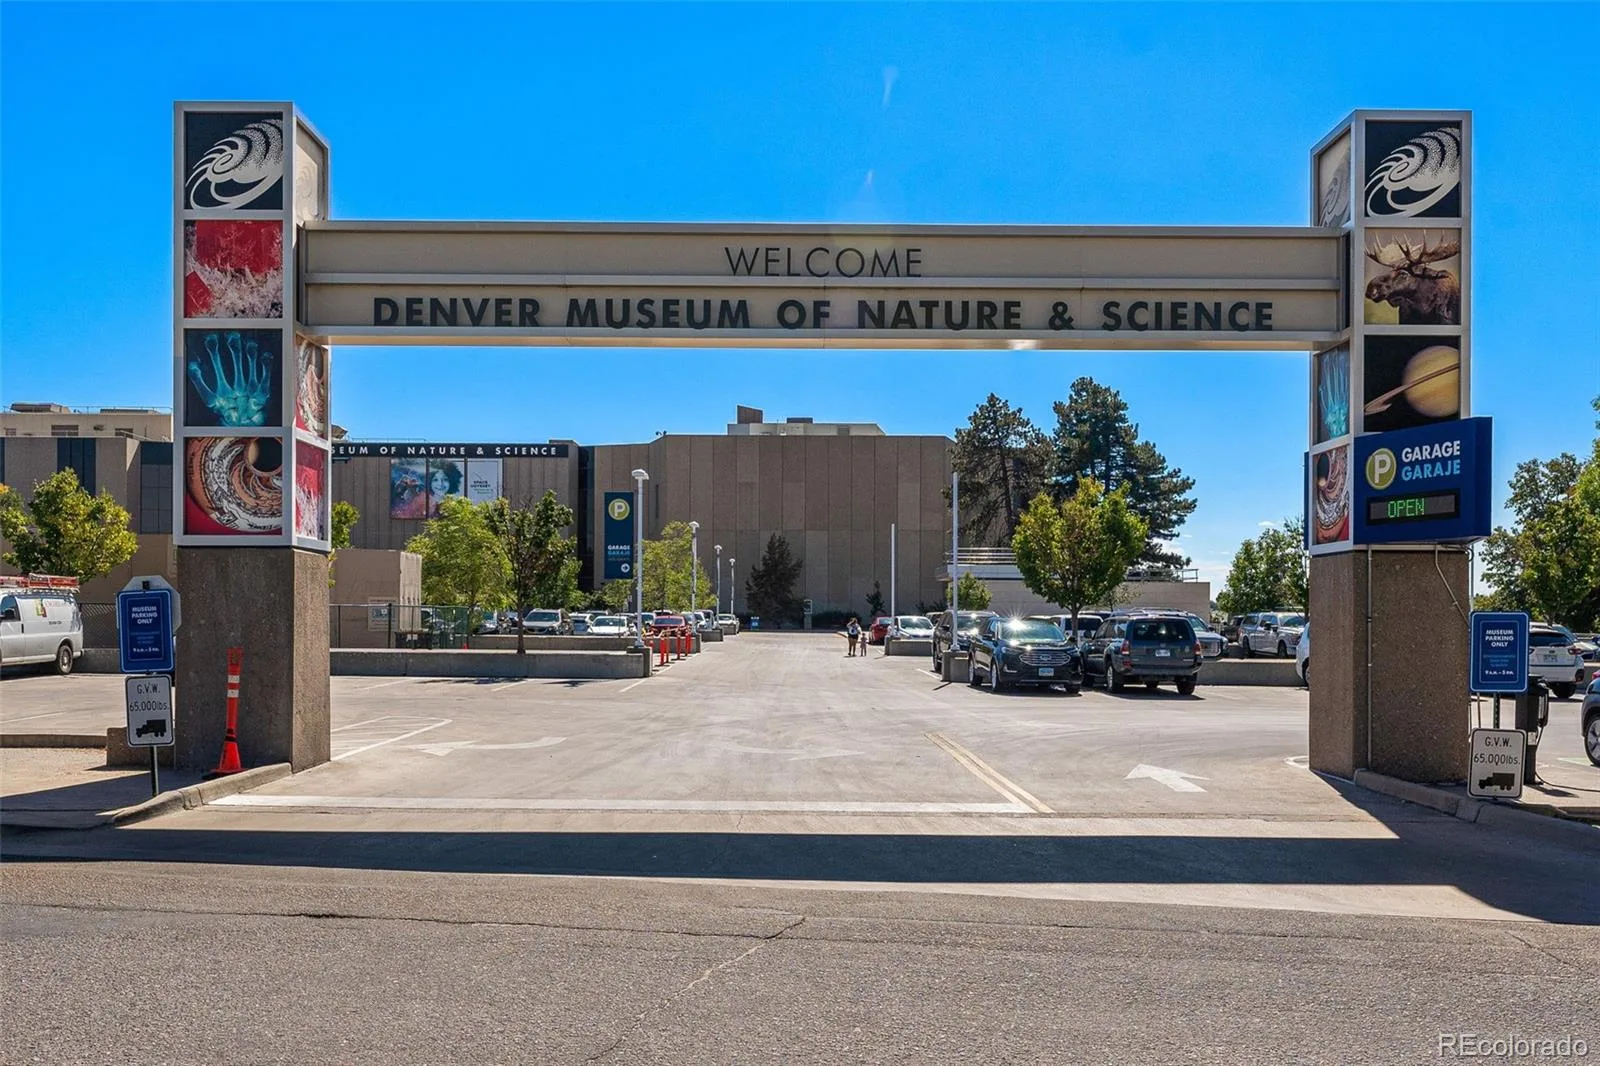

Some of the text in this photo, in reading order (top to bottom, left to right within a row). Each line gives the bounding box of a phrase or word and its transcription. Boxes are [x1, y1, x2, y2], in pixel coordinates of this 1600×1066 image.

[724, 247, 922, 278] WELCOME
[373, 297, 1274, 333] DENVER MUSEUM OF NATURE & SCIENCE
[379, 446, 397, 455] OF
[407, 446, 466, 455] NATURE
[476, 446, 484, 456] &
[495, 446, 557, 456] SCIENCE
[1401, 440, 1461, 463] GARAGE
[1374, 454, 1391, 484] P
[1401, 459, 1461, 481] GARAJE
[614, 502, 626, 516] P
[1387, 498, 1425, 518] OPEN
[136, 683, 161, 695] G.V.W.
[1484, 736, 1512, 747] G.V.W.
